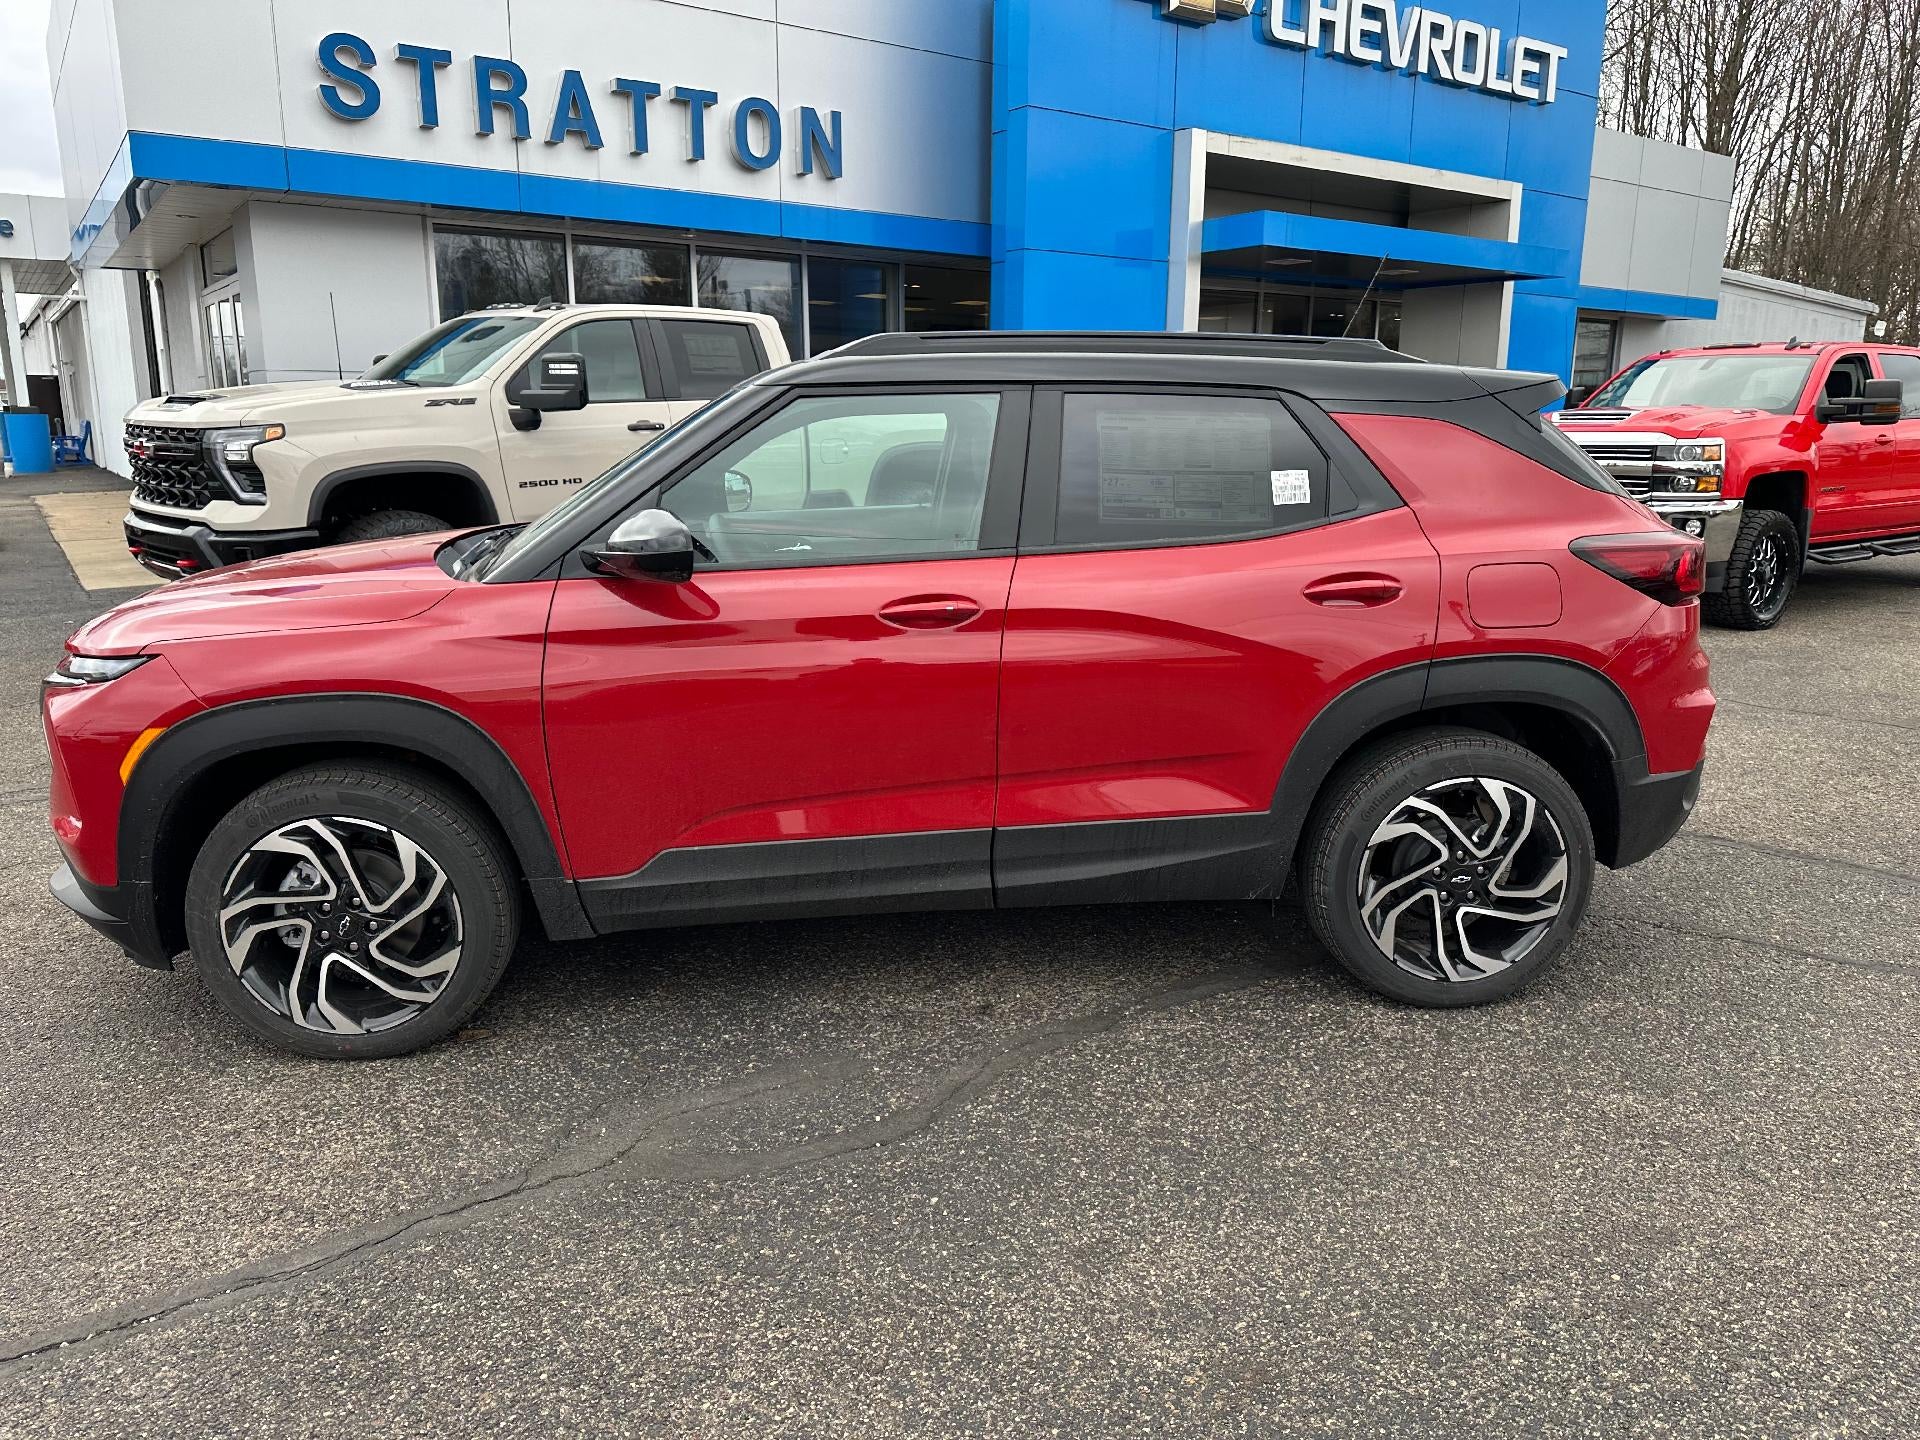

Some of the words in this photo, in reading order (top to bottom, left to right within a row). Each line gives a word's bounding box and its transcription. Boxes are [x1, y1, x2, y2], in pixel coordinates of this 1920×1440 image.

[1264, 0, 1567, 104] CHEVROLET
[317, 32, 843, 179] STRATTON
[518, 479, 559, 489] 2500
[562, 477, 583, 485] HD
